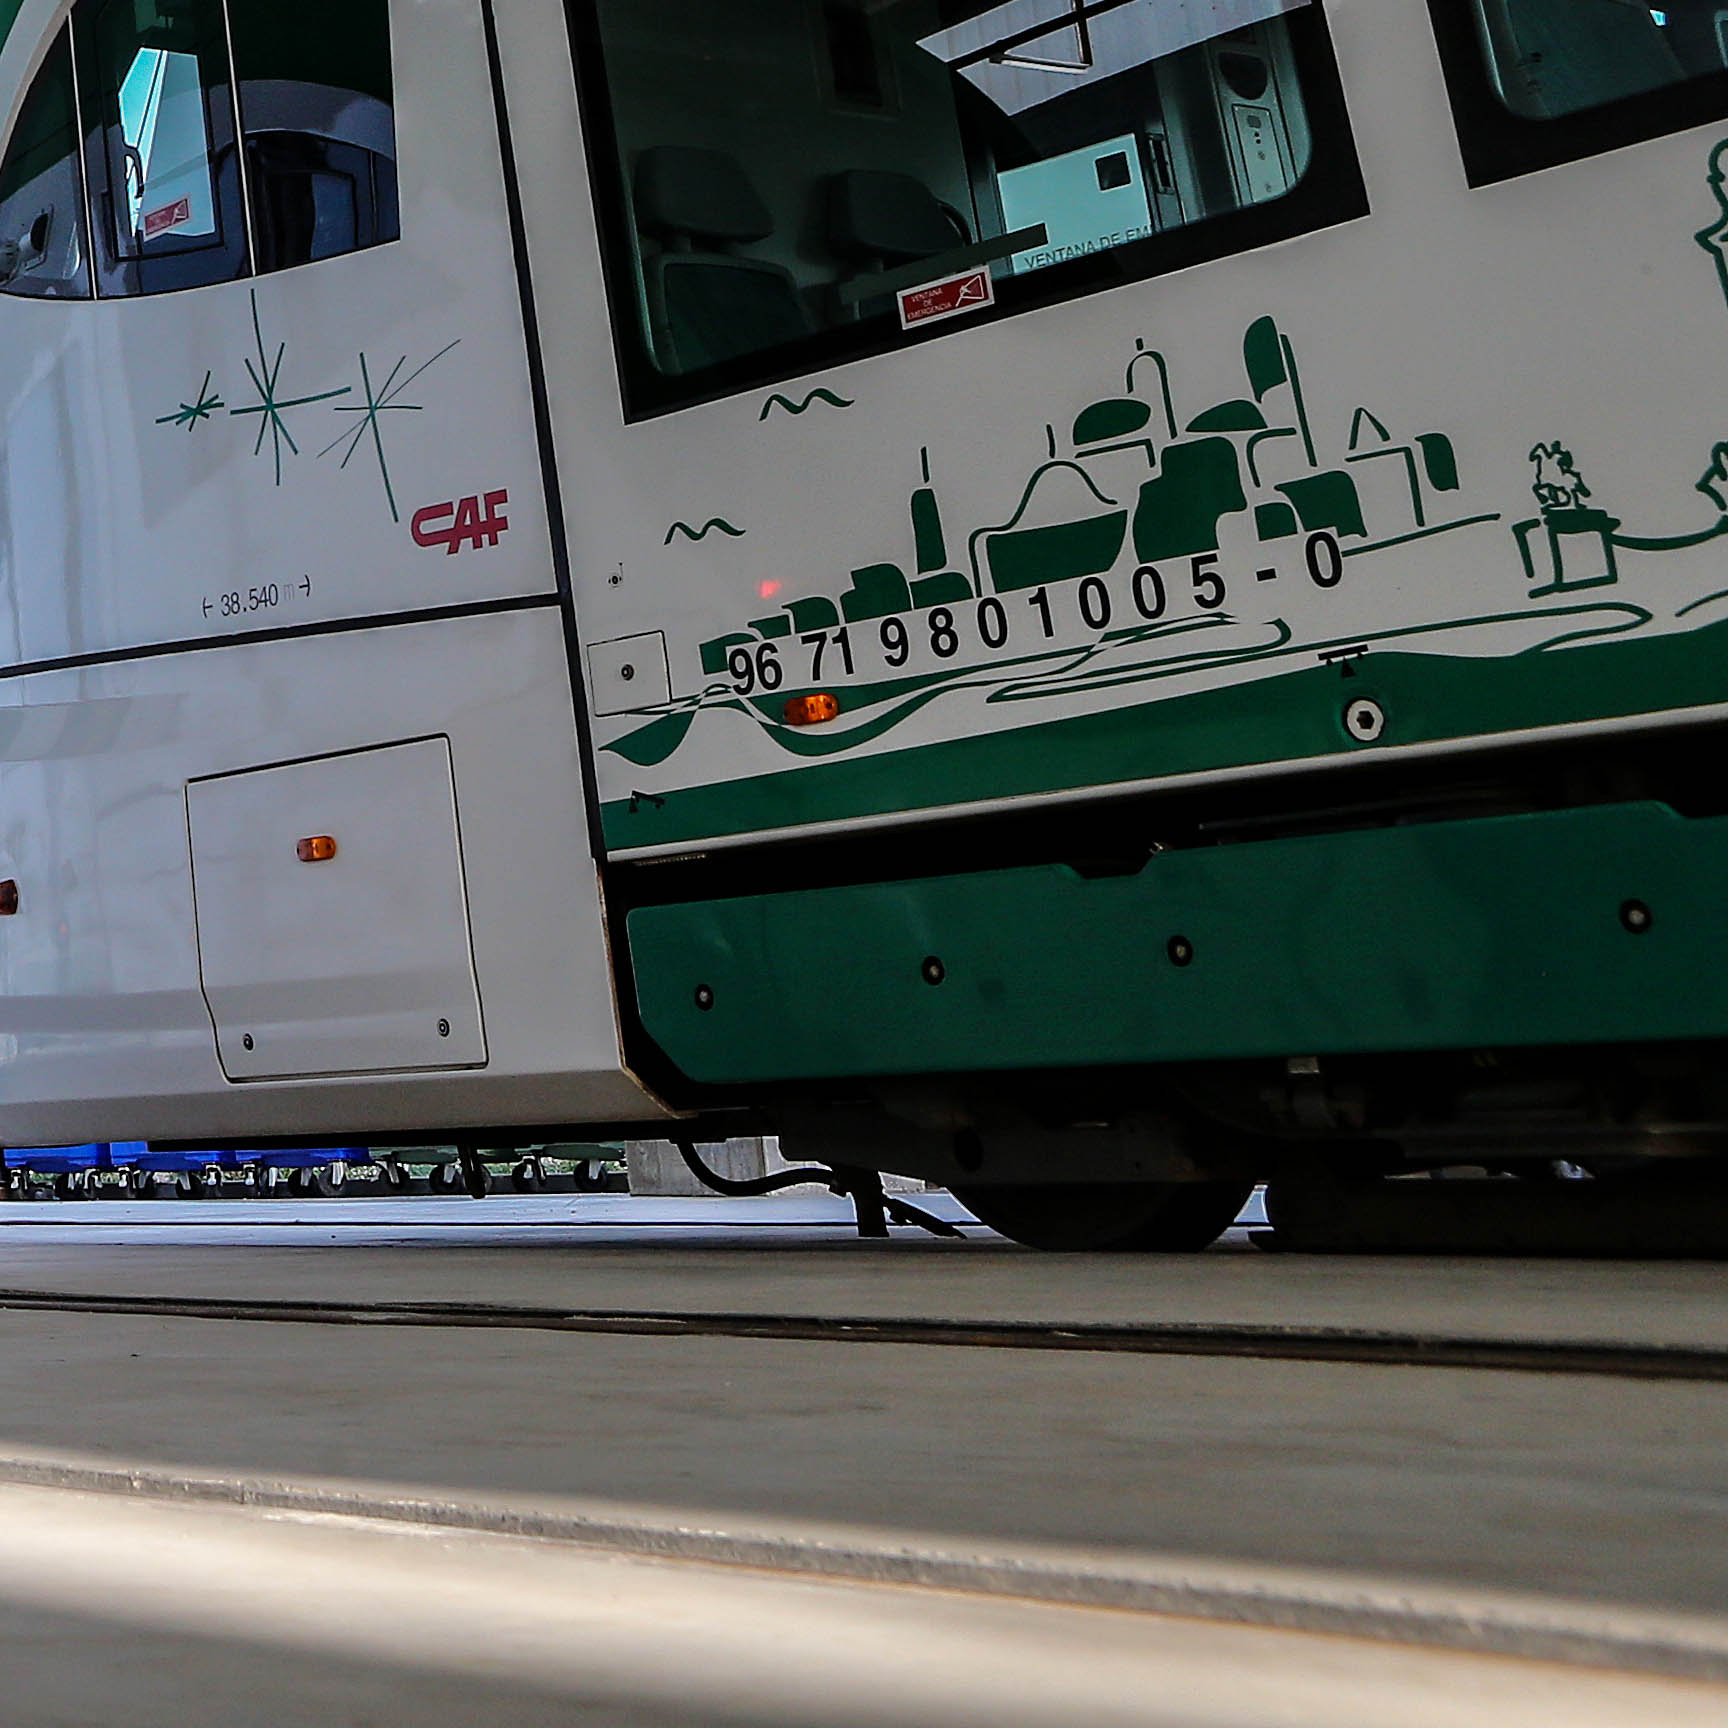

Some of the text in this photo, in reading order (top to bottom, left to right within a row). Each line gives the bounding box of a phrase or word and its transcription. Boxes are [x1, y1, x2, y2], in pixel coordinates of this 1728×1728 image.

[1023, 239, 1095, 270] VENTANA
[1099, 231, 1121, 253] DE
[410, 488, 510, 555] CAF
[220, 583, 279, 617] 38.540
